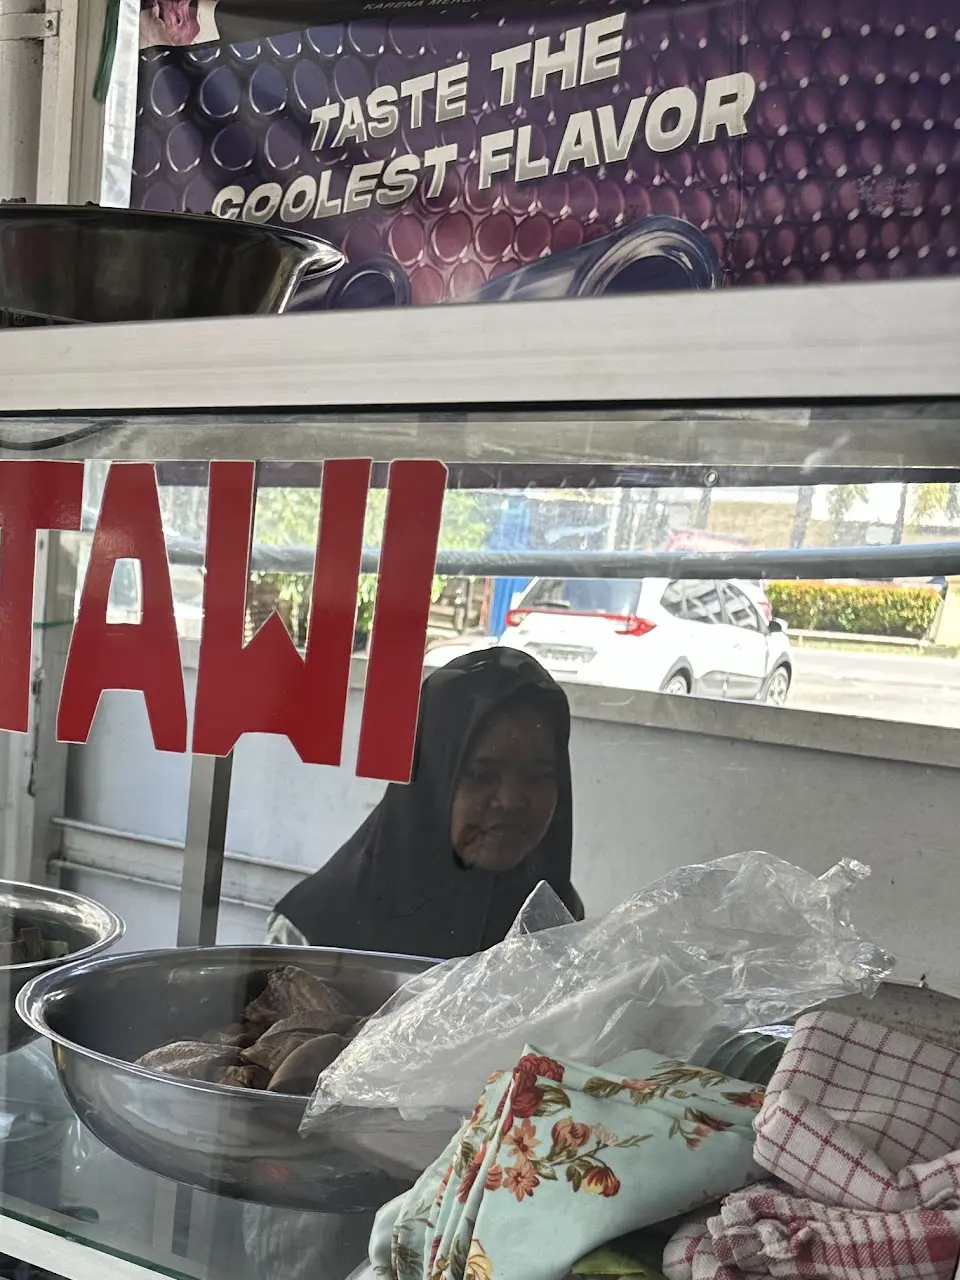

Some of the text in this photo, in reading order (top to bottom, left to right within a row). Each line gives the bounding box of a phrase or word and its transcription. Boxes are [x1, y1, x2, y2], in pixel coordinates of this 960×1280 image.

[210, 71, 756, 224] COOLEST FLAVOR
[309, 12, 628, 152] TASTE THE
